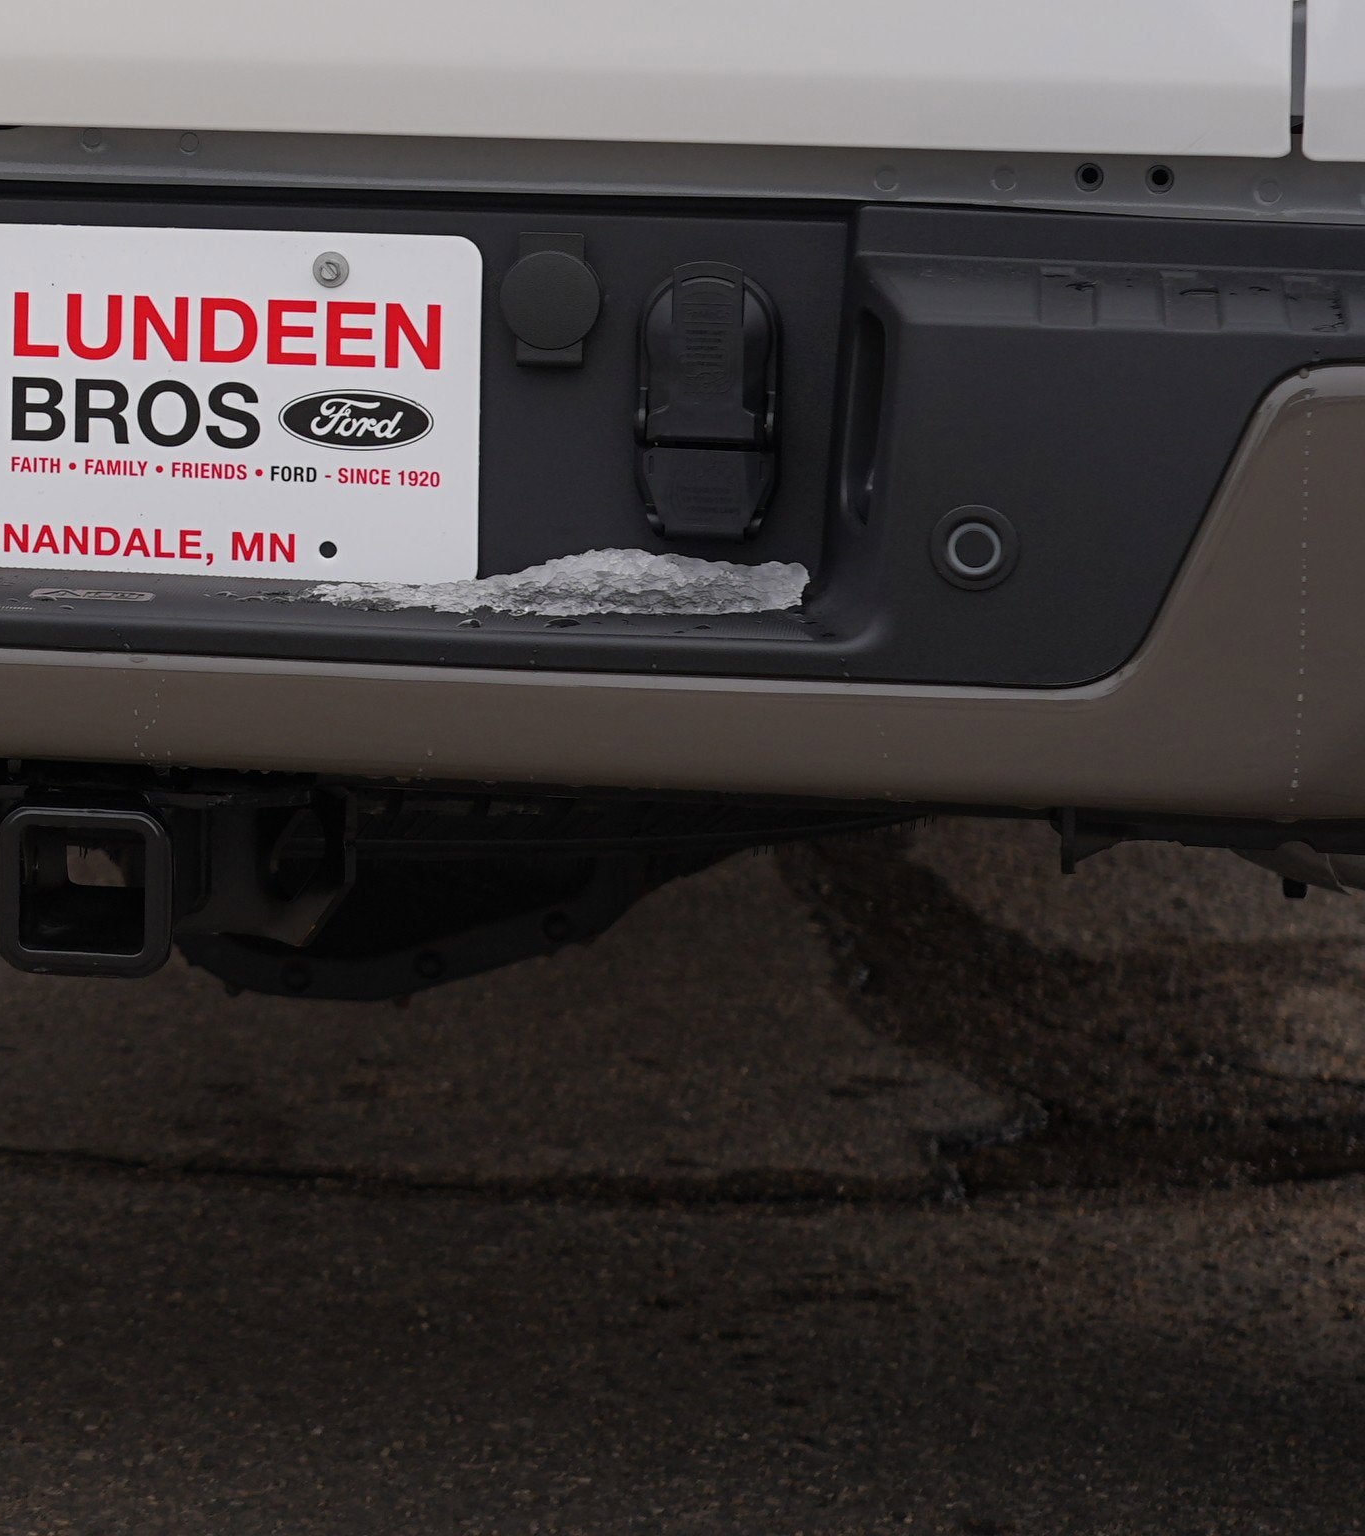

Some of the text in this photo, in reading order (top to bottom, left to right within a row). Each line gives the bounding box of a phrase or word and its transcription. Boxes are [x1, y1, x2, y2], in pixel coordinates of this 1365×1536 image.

[12, 291, 443, 371] LUNDEEN
[11, 376, 405, 450] BROS Ford
[11, 457, 441, 487] FAITH FAMILY FRIENDS FORD SINCE 1920
[231, 531, 296, 563] MN
